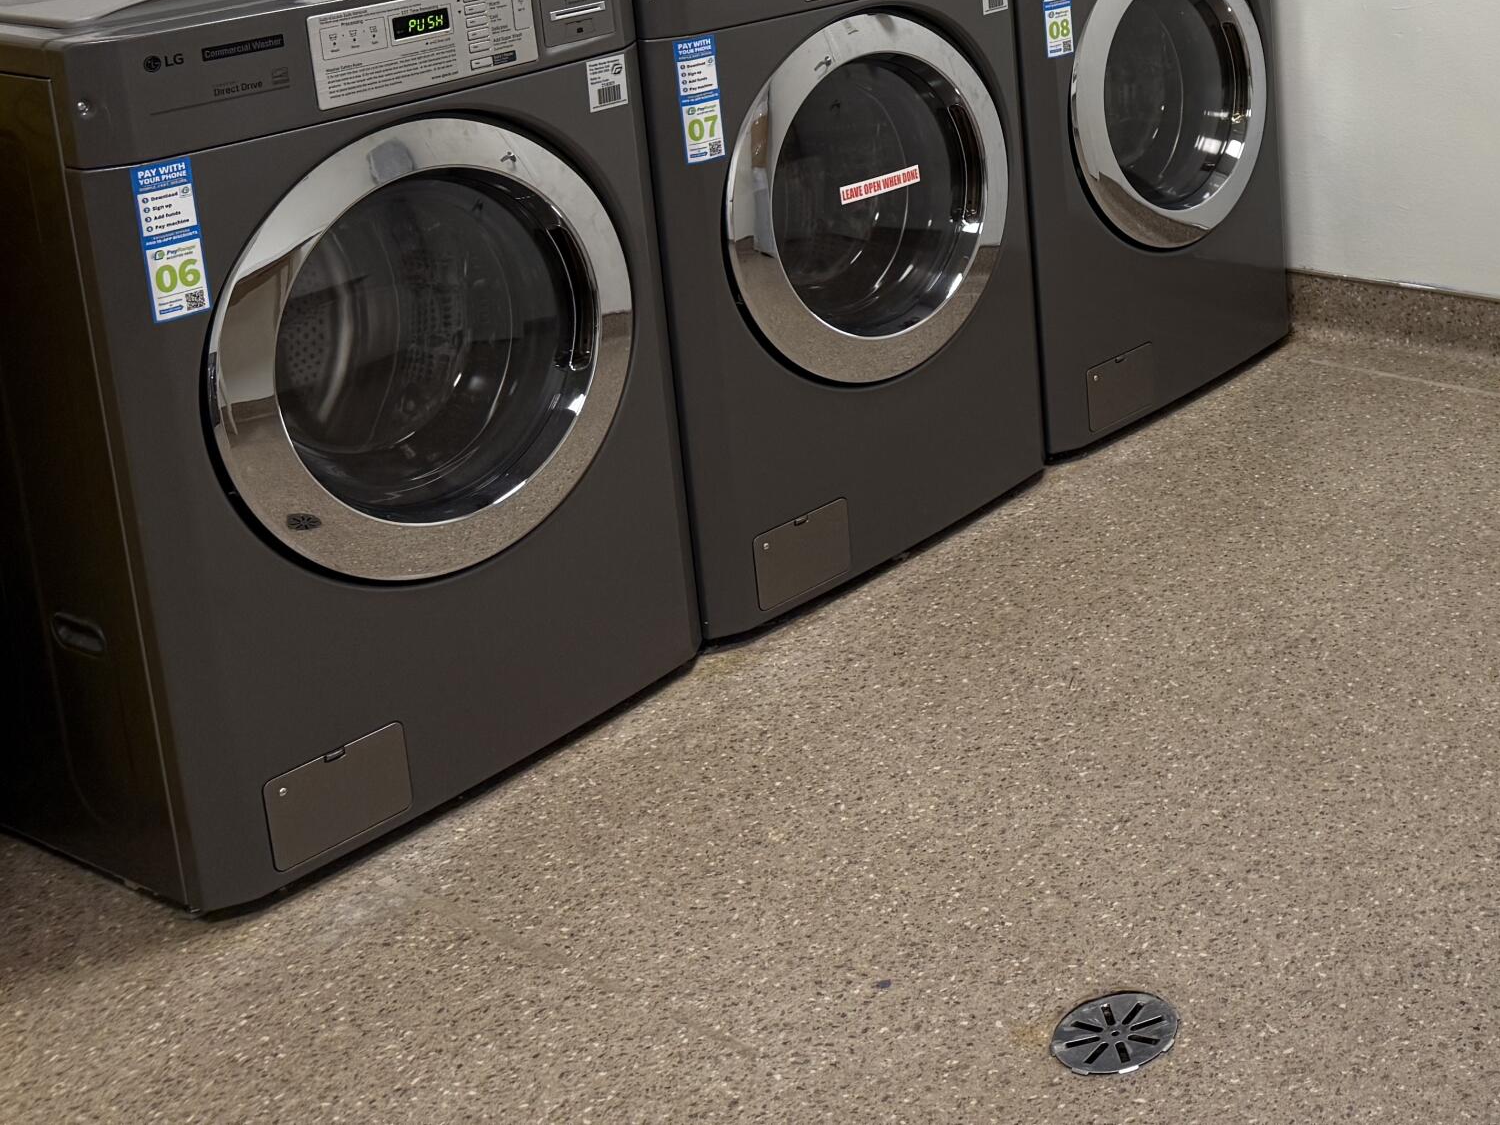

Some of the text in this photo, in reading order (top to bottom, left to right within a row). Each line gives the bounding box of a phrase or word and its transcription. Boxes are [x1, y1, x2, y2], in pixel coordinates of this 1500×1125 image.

[408, 14, 443, 32] PUSH
[1048, 18, 1070, 40] 08
[204, 36, 282, 59] Commercial Washer
[677, 38, 711, 50] PAY WITH
[678, 48, 694, 56] YOUR
[164, 53, 184, 67] LG
[213, 86, 240, 97] Direct
[241, 80, 263, 92] Drive
[688, 114, 718, 142] 07
[137, 162, 186, 180] PAY WITH
[138, 175, 161, 186] YOUR
[162, 169, 188, 181] PHONE
[842, 168, 919, 201] LEAVE OPEN WHEN DONE
[150, 191, 179, 202] Download
[152, 204, 164, 212] Sign
[164, 203, 173, 211] up
[154, 213, 164, 221] Add
[165, 210, 182, 218] funds
[166, 218, 190, 227] machine
[156, 258, 201, 293] 06
